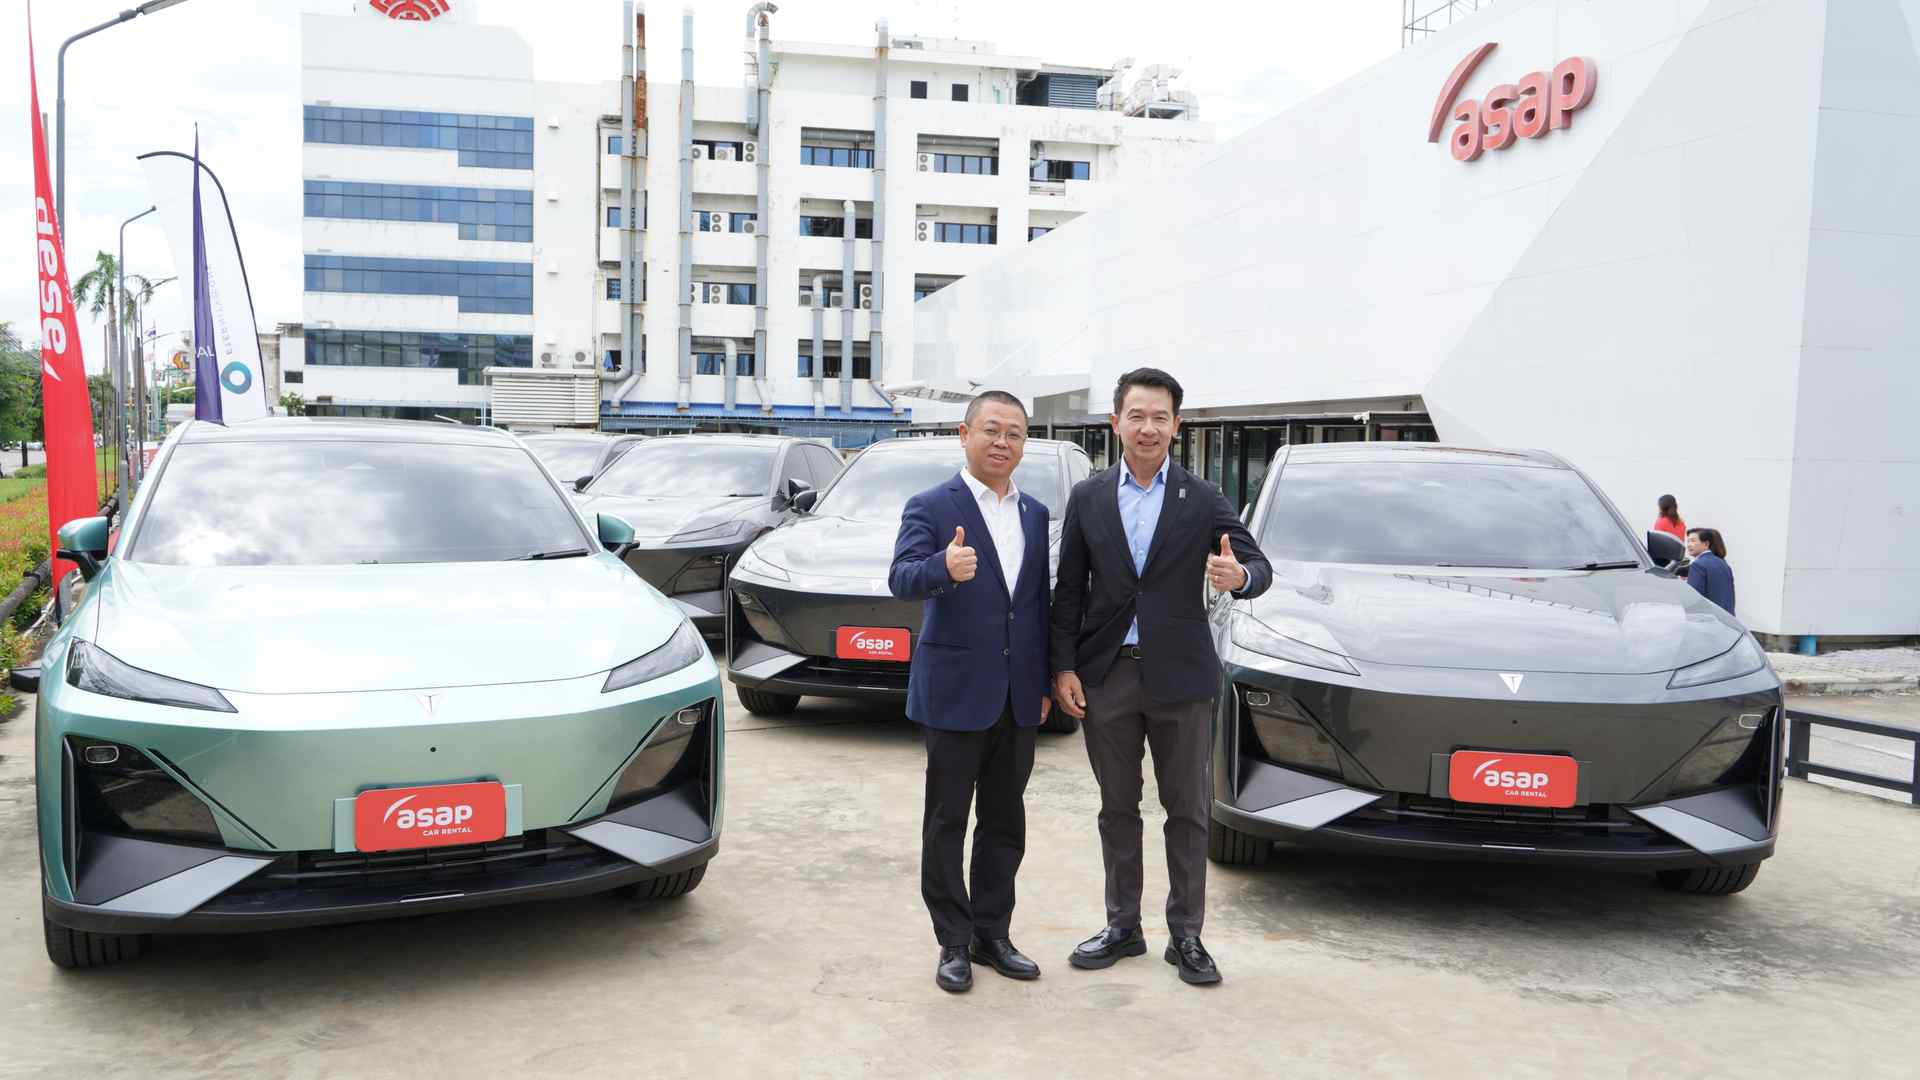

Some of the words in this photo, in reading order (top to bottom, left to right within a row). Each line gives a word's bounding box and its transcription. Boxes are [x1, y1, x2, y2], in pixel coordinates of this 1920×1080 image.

[1450, 56, 1598, 162] asap
[36, 196, 67, 354] asap
[856, 638, 894, 650] asap
[1483, 769, 1549, 789] asap
[396, 805, 473, 829] asap
[441, 827, 472, 835] RENTAL
